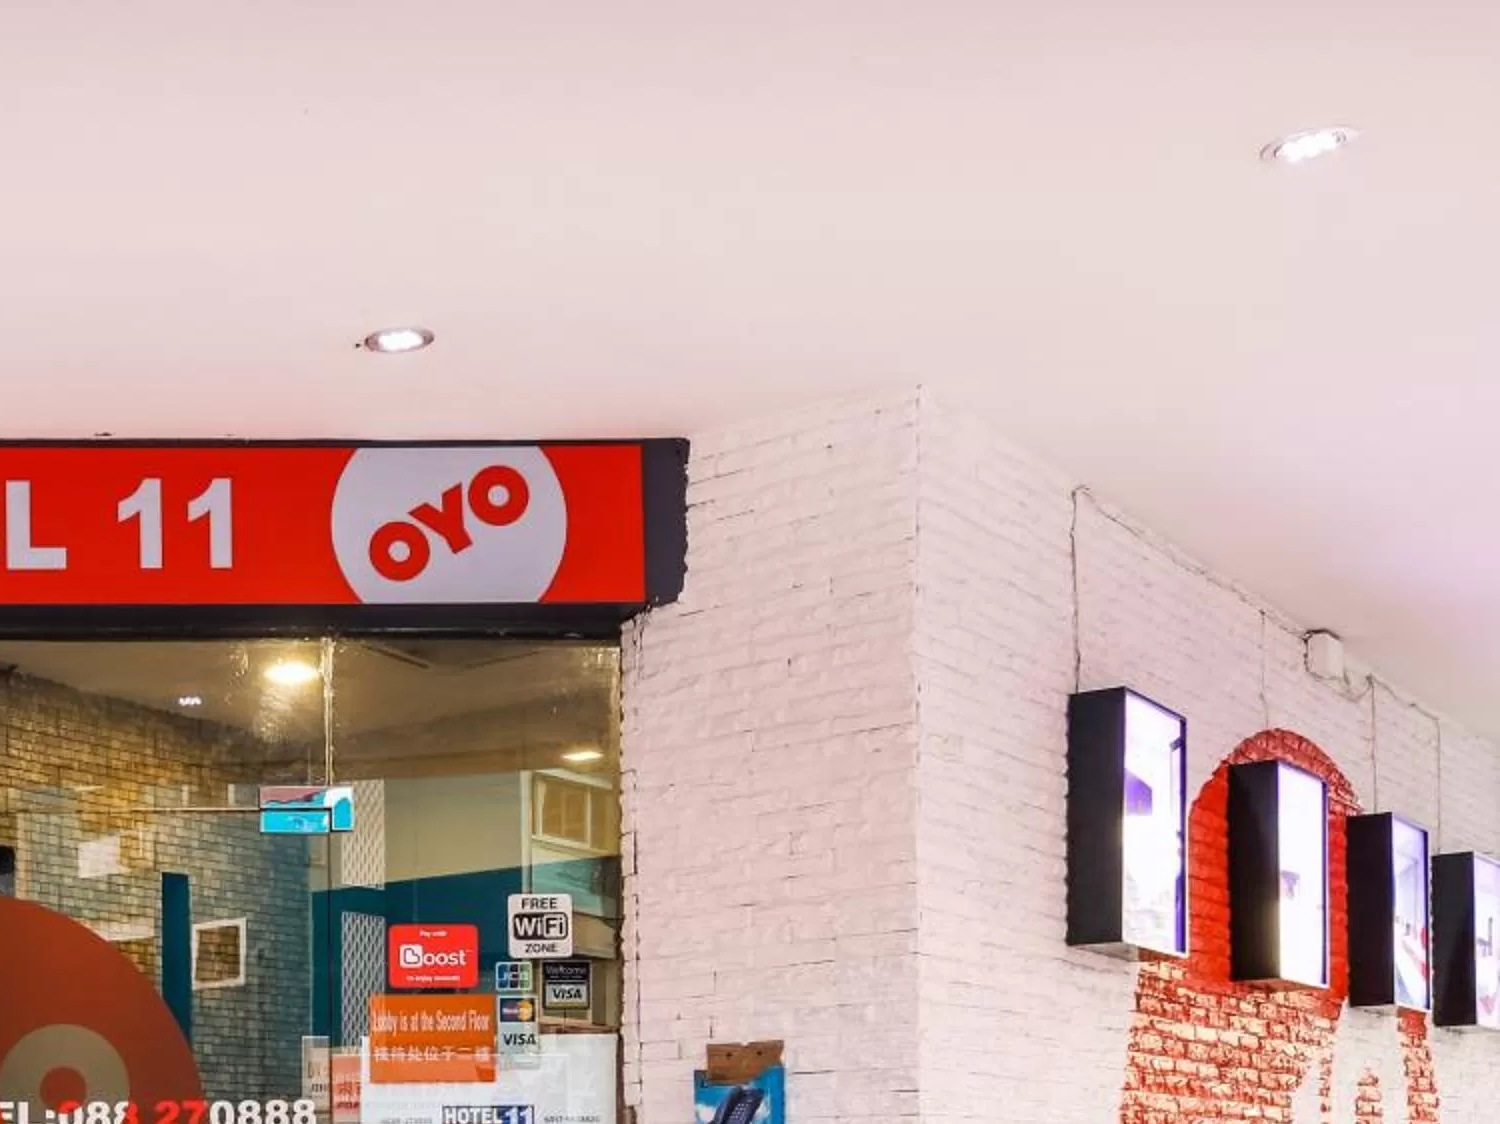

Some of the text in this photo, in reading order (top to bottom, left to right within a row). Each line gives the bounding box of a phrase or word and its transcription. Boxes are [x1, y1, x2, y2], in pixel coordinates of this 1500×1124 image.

[117, 478, 233, 569] 11
[369, 465, 529, 581] OYO
[521, 897, 558, 909] FREE
[515, 916, 564, 936] WiFi
[525, 943, 558, 953] ZONE
[552, 988, 583, 999] VISA
[435, 1010, 466, 1032] Second
[503, 1034, 537, 1046] VISA
[445, 1107, 503, 1124] HOTEL
